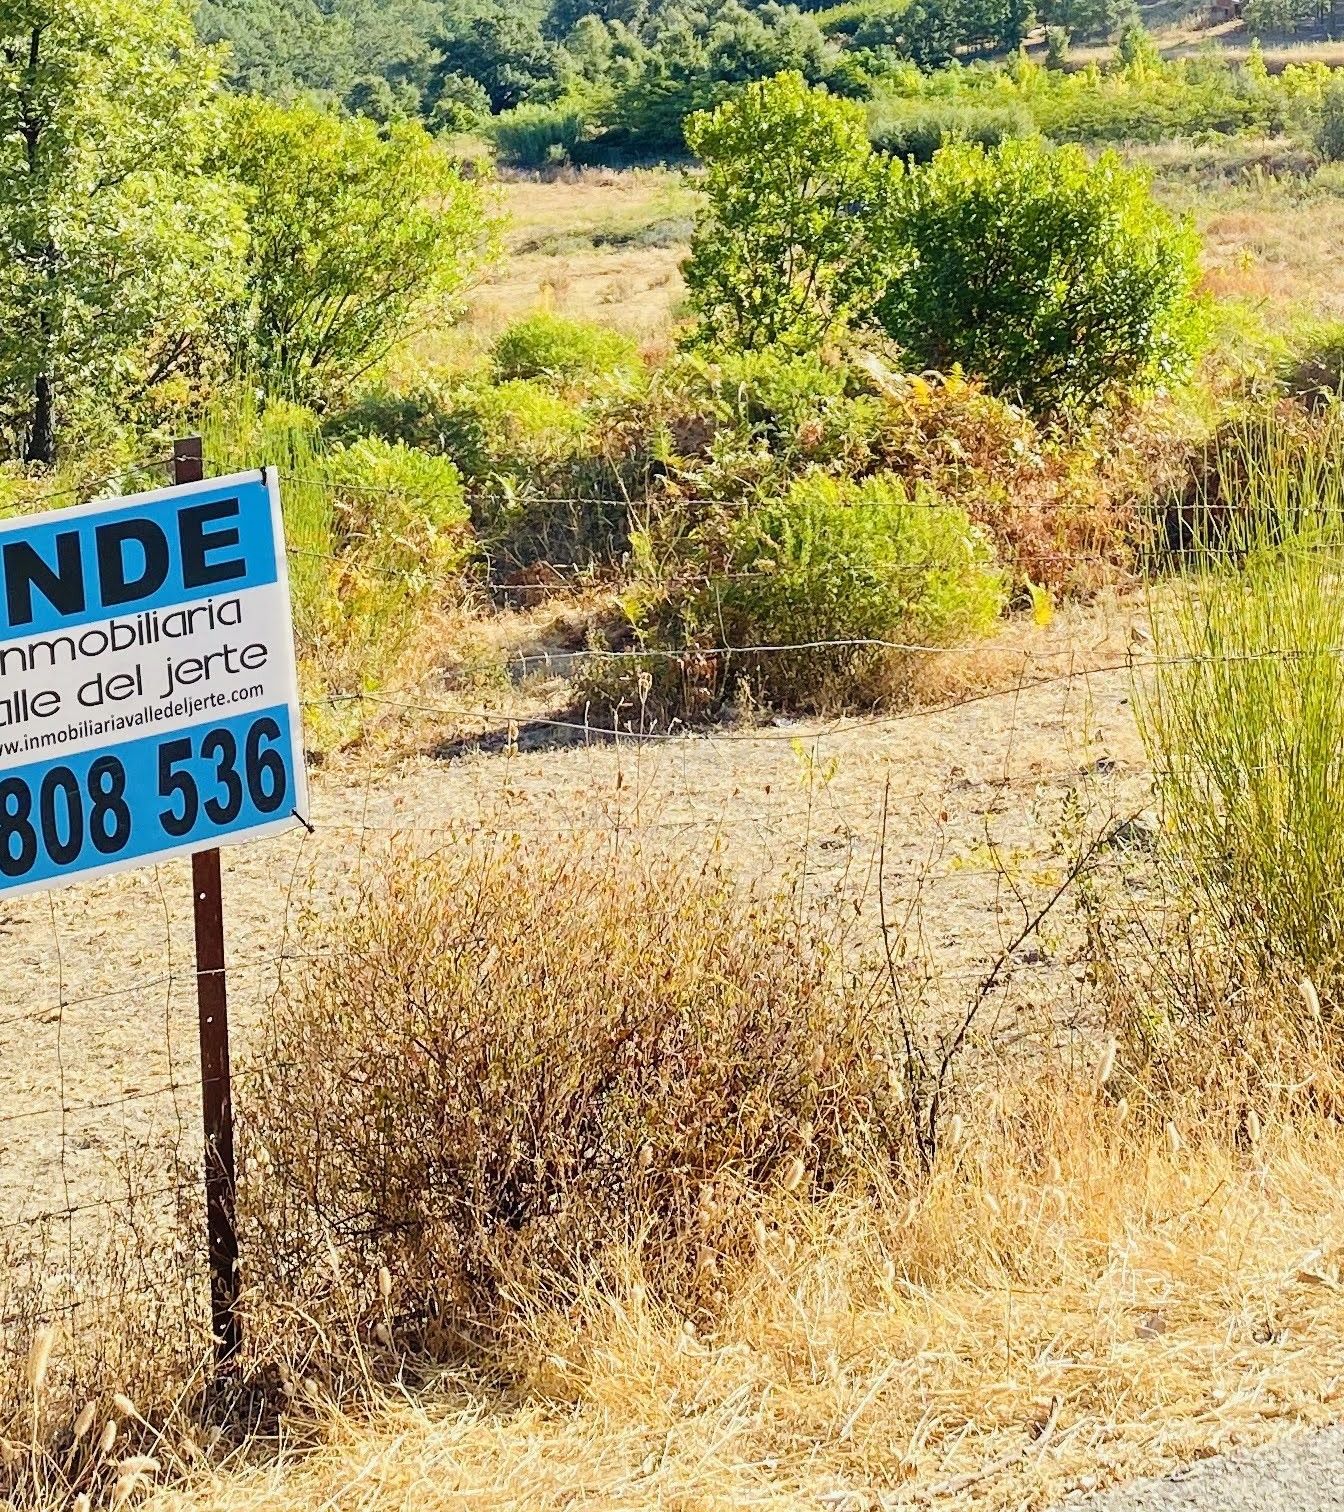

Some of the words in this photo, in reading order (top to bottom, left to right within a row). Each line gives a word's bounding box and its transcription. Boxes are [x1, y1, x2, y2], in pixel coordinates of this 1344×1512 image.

[77, 664, 143, 707] del
[160, 643, 268, 699] jerte
[158, 717, 287, 837] 536
